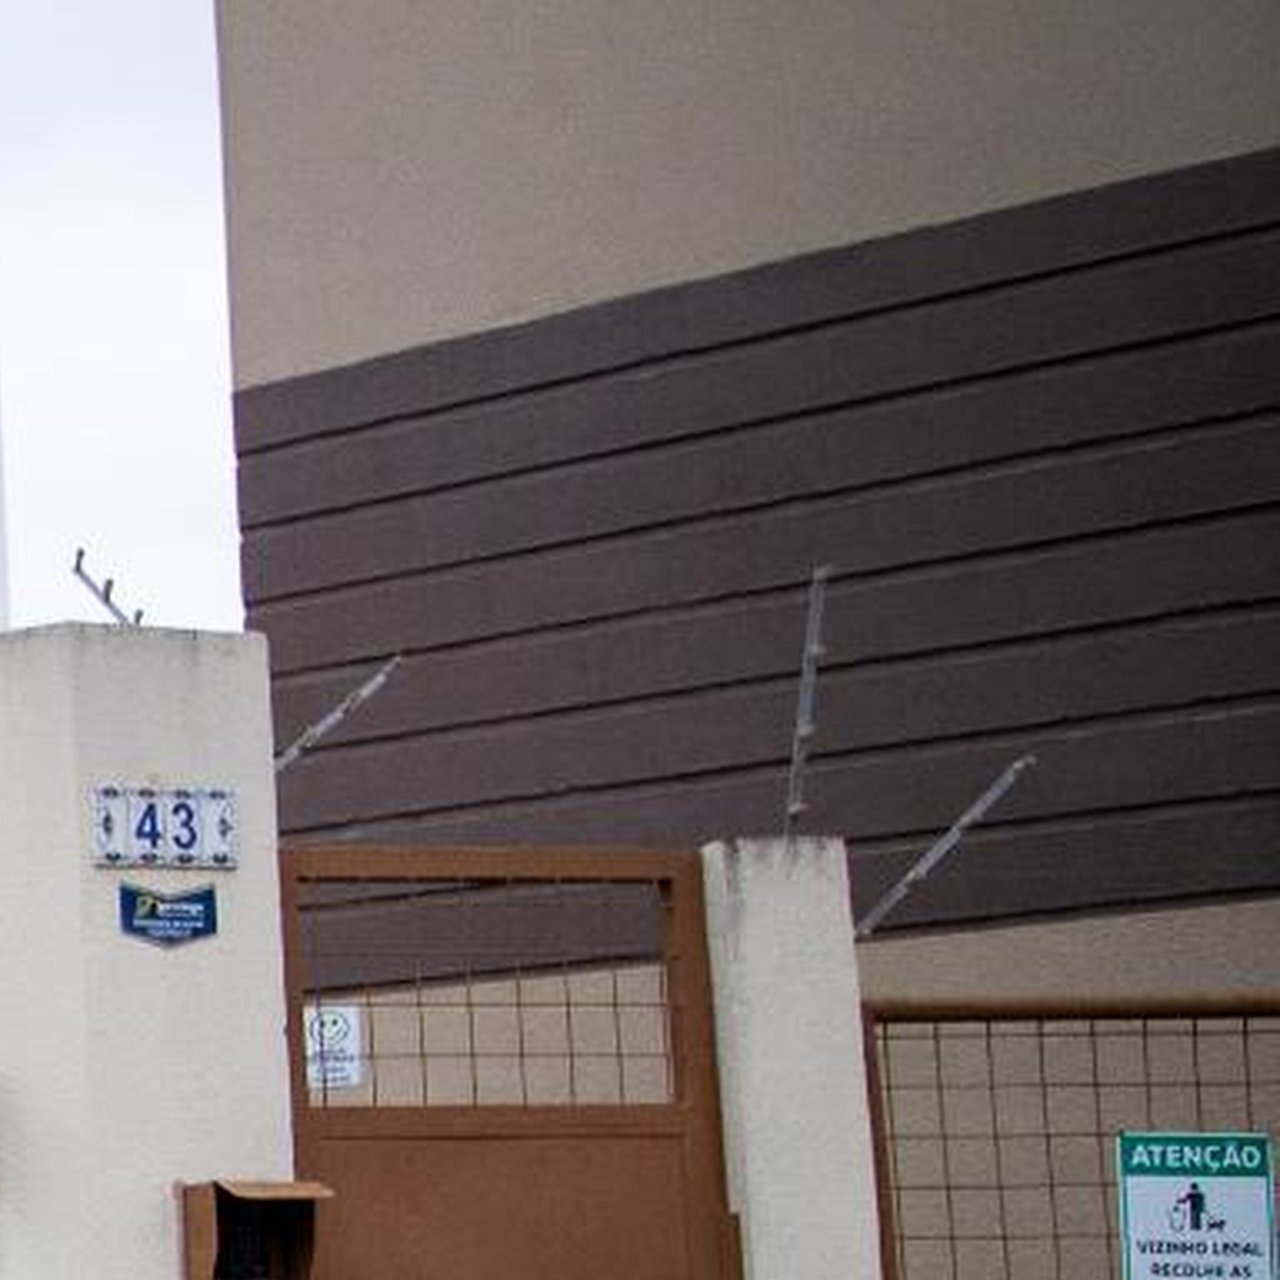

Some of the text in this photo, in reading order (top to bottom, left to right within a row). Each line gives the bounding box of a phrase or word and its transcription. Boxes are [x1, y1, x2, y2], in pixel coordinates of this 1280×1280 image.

[136, 803, 197, 849] 43
[1130, 1141, 1261, 1172] ATENÇÃO
[1136, 1240, 1264, 1257] VIZINHO LEGAL
[1230, 1263, 1253, 1279] AS
